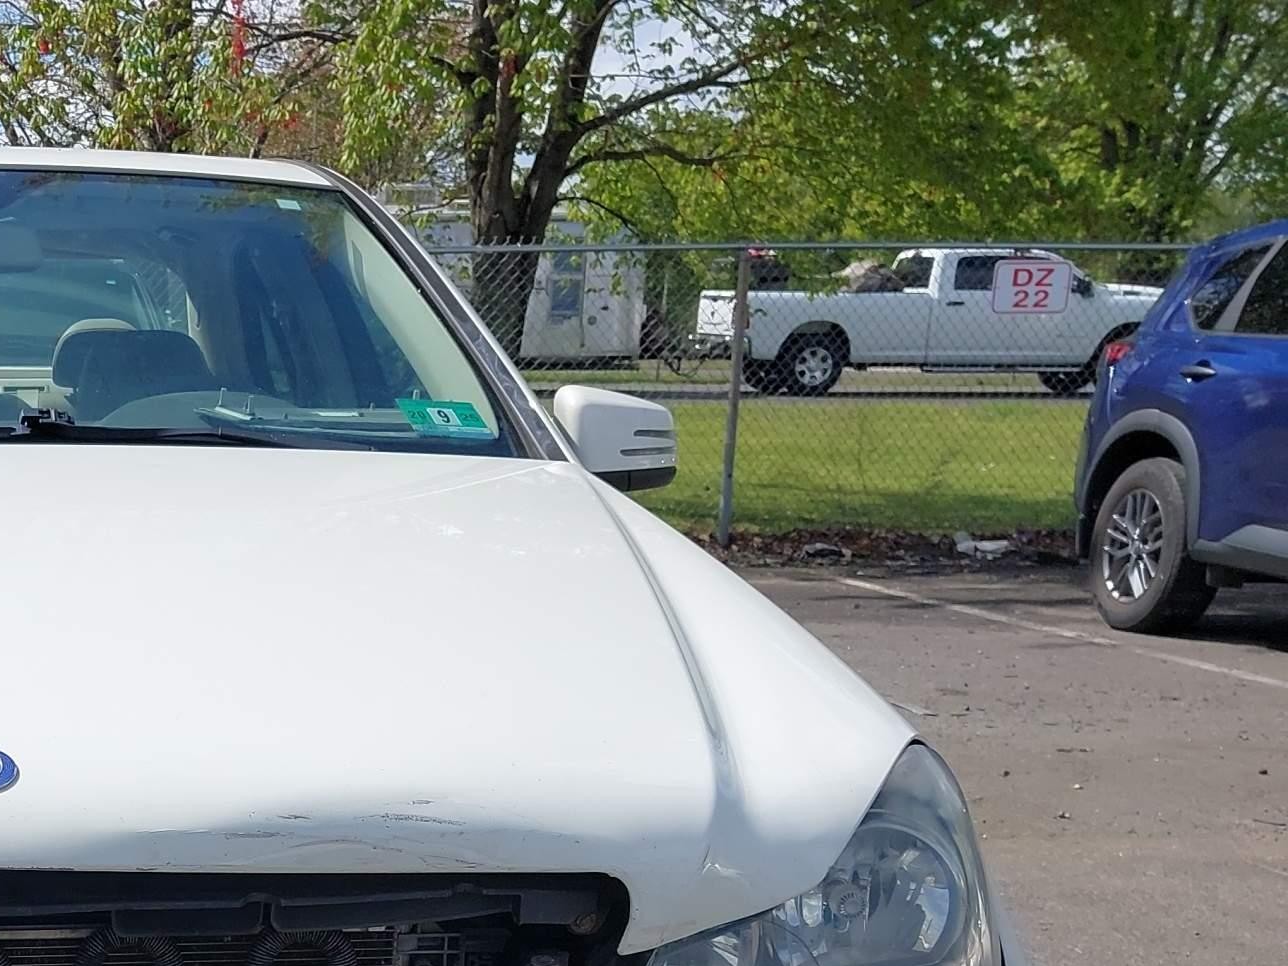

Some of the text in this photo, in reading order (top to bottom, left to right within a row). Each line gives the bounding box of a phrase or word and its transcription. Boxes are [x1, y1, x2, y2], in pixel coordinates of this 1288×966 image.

[1012, 268, 1055, 287] DZ
[1012, 289, 1049, 308] 22
[436, 409, 451, 424] 9
